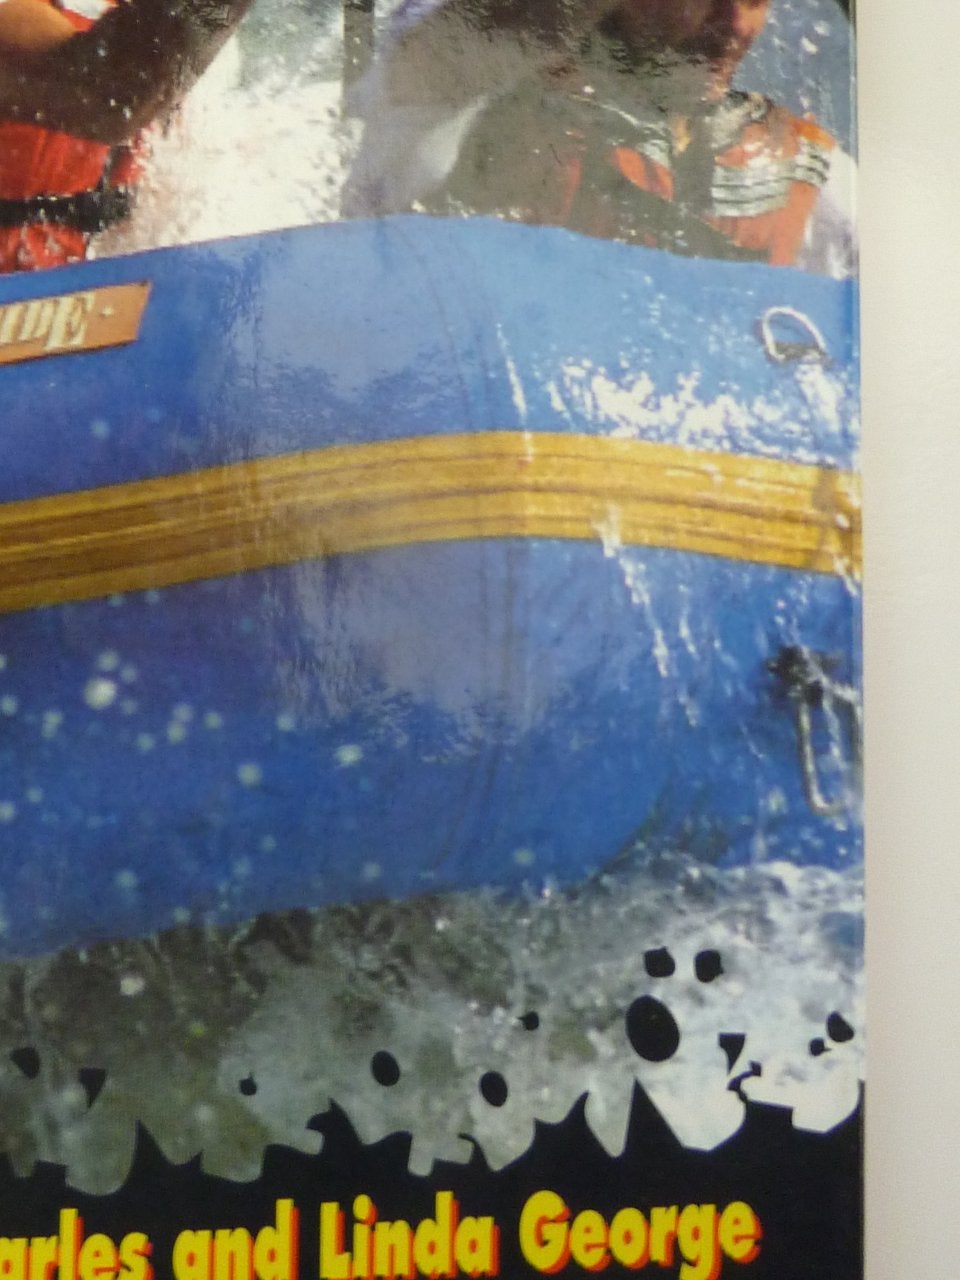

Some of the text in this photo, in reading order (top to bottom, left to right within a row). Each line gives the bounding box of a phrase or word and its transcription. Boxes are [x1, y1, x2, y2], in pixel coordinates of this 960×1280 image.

[172, 1198, 300, 1280] and
[320, 1190, 501, 1280] Linda
[519, 1189, 763, 1280] George
